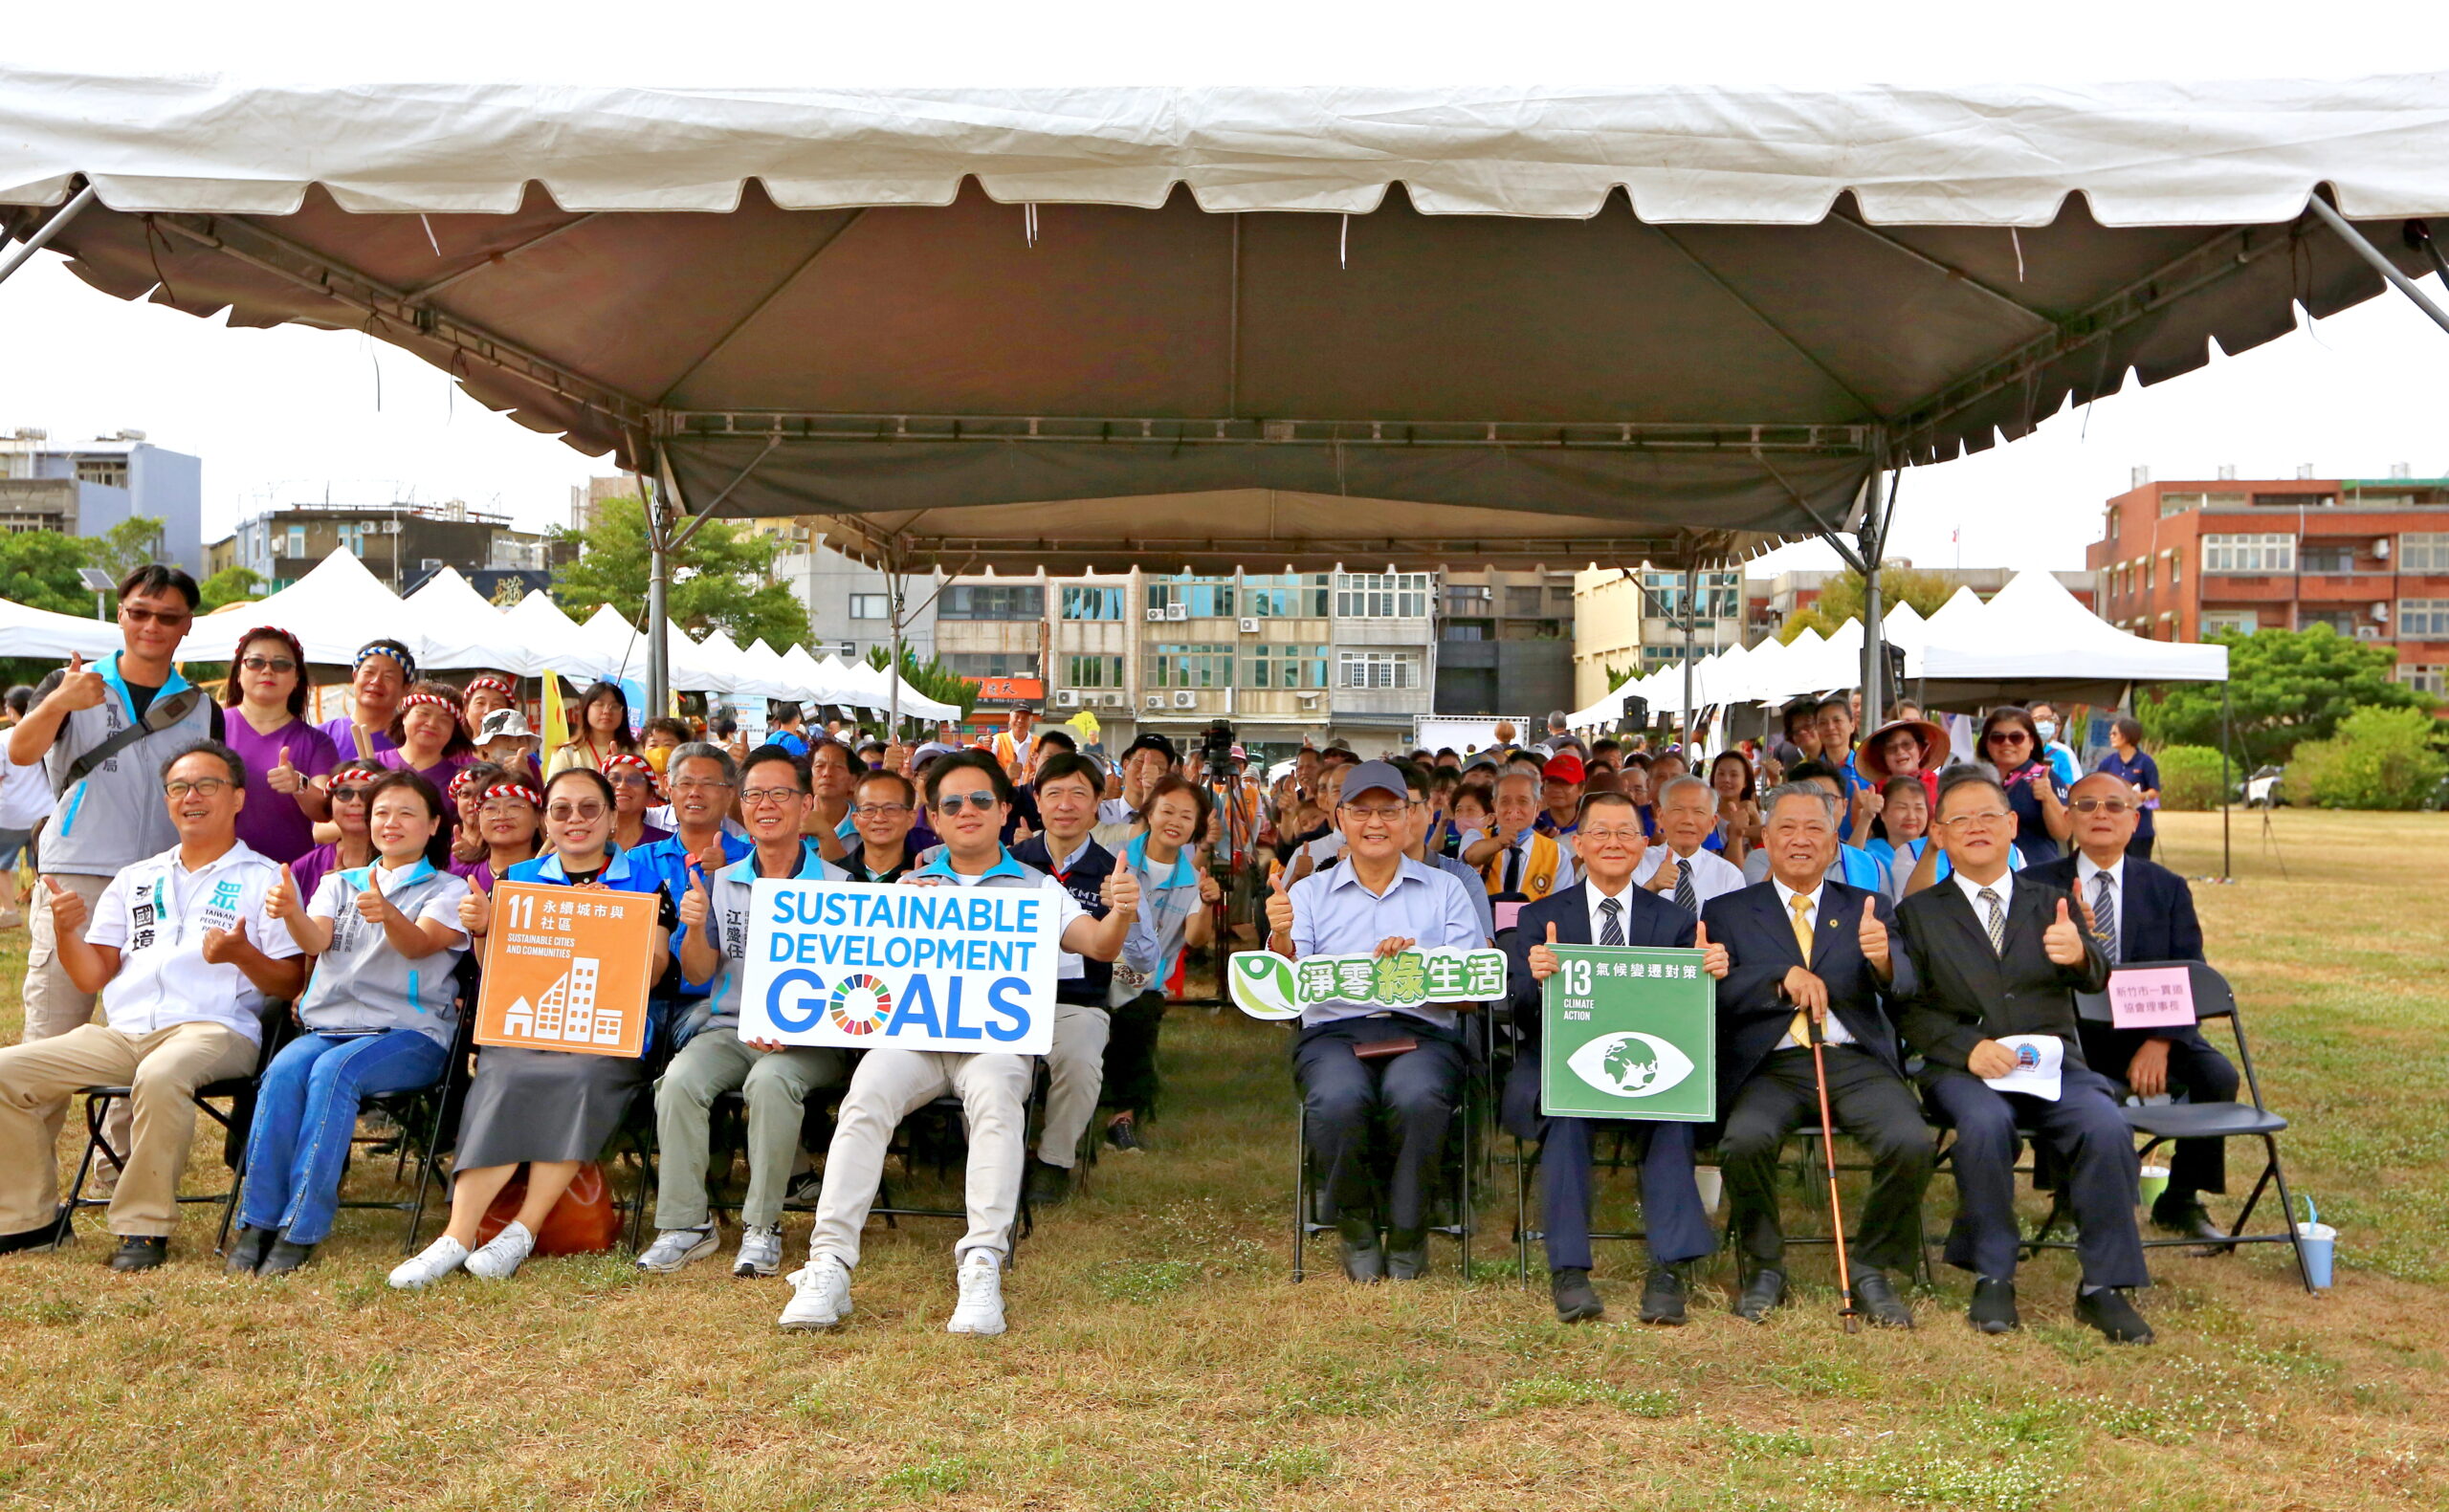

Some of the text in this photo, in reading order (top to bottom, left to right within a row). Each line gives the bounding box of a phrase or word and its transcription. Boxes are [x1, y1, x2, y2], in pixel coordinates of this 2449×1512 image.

[1069, 887, 1101, 902] KMT
[206, 909, 235, 921] TAIWAN
[508, 894, 534, 930] 11
[543, 900, 624, 918] 永續城市與
[772, 890, 1040, 933] SUSTAINABLE
[200, 917, 232, 930] PEOPLE'S
[541, 916, 572, 931] 社區
[508, 932, 575, 948] SUSTAINABLE CITIES
[506, 945, 571, 959] AND COMMUNITIES
[769, 932, 1036, 972] DEVELOPMENT
[1298, 952, 1504, 1004] 淨零綠生活
[1561, 959, 1592, 996] 13
[1596, 962, 1697, 979] 氣候變遷對策
[766, 969, 1031, 1041] GOALS
[1563, 998, 1595, 1009] CLIMATE
[1563, 1010, 1591, 1020] ACTION
